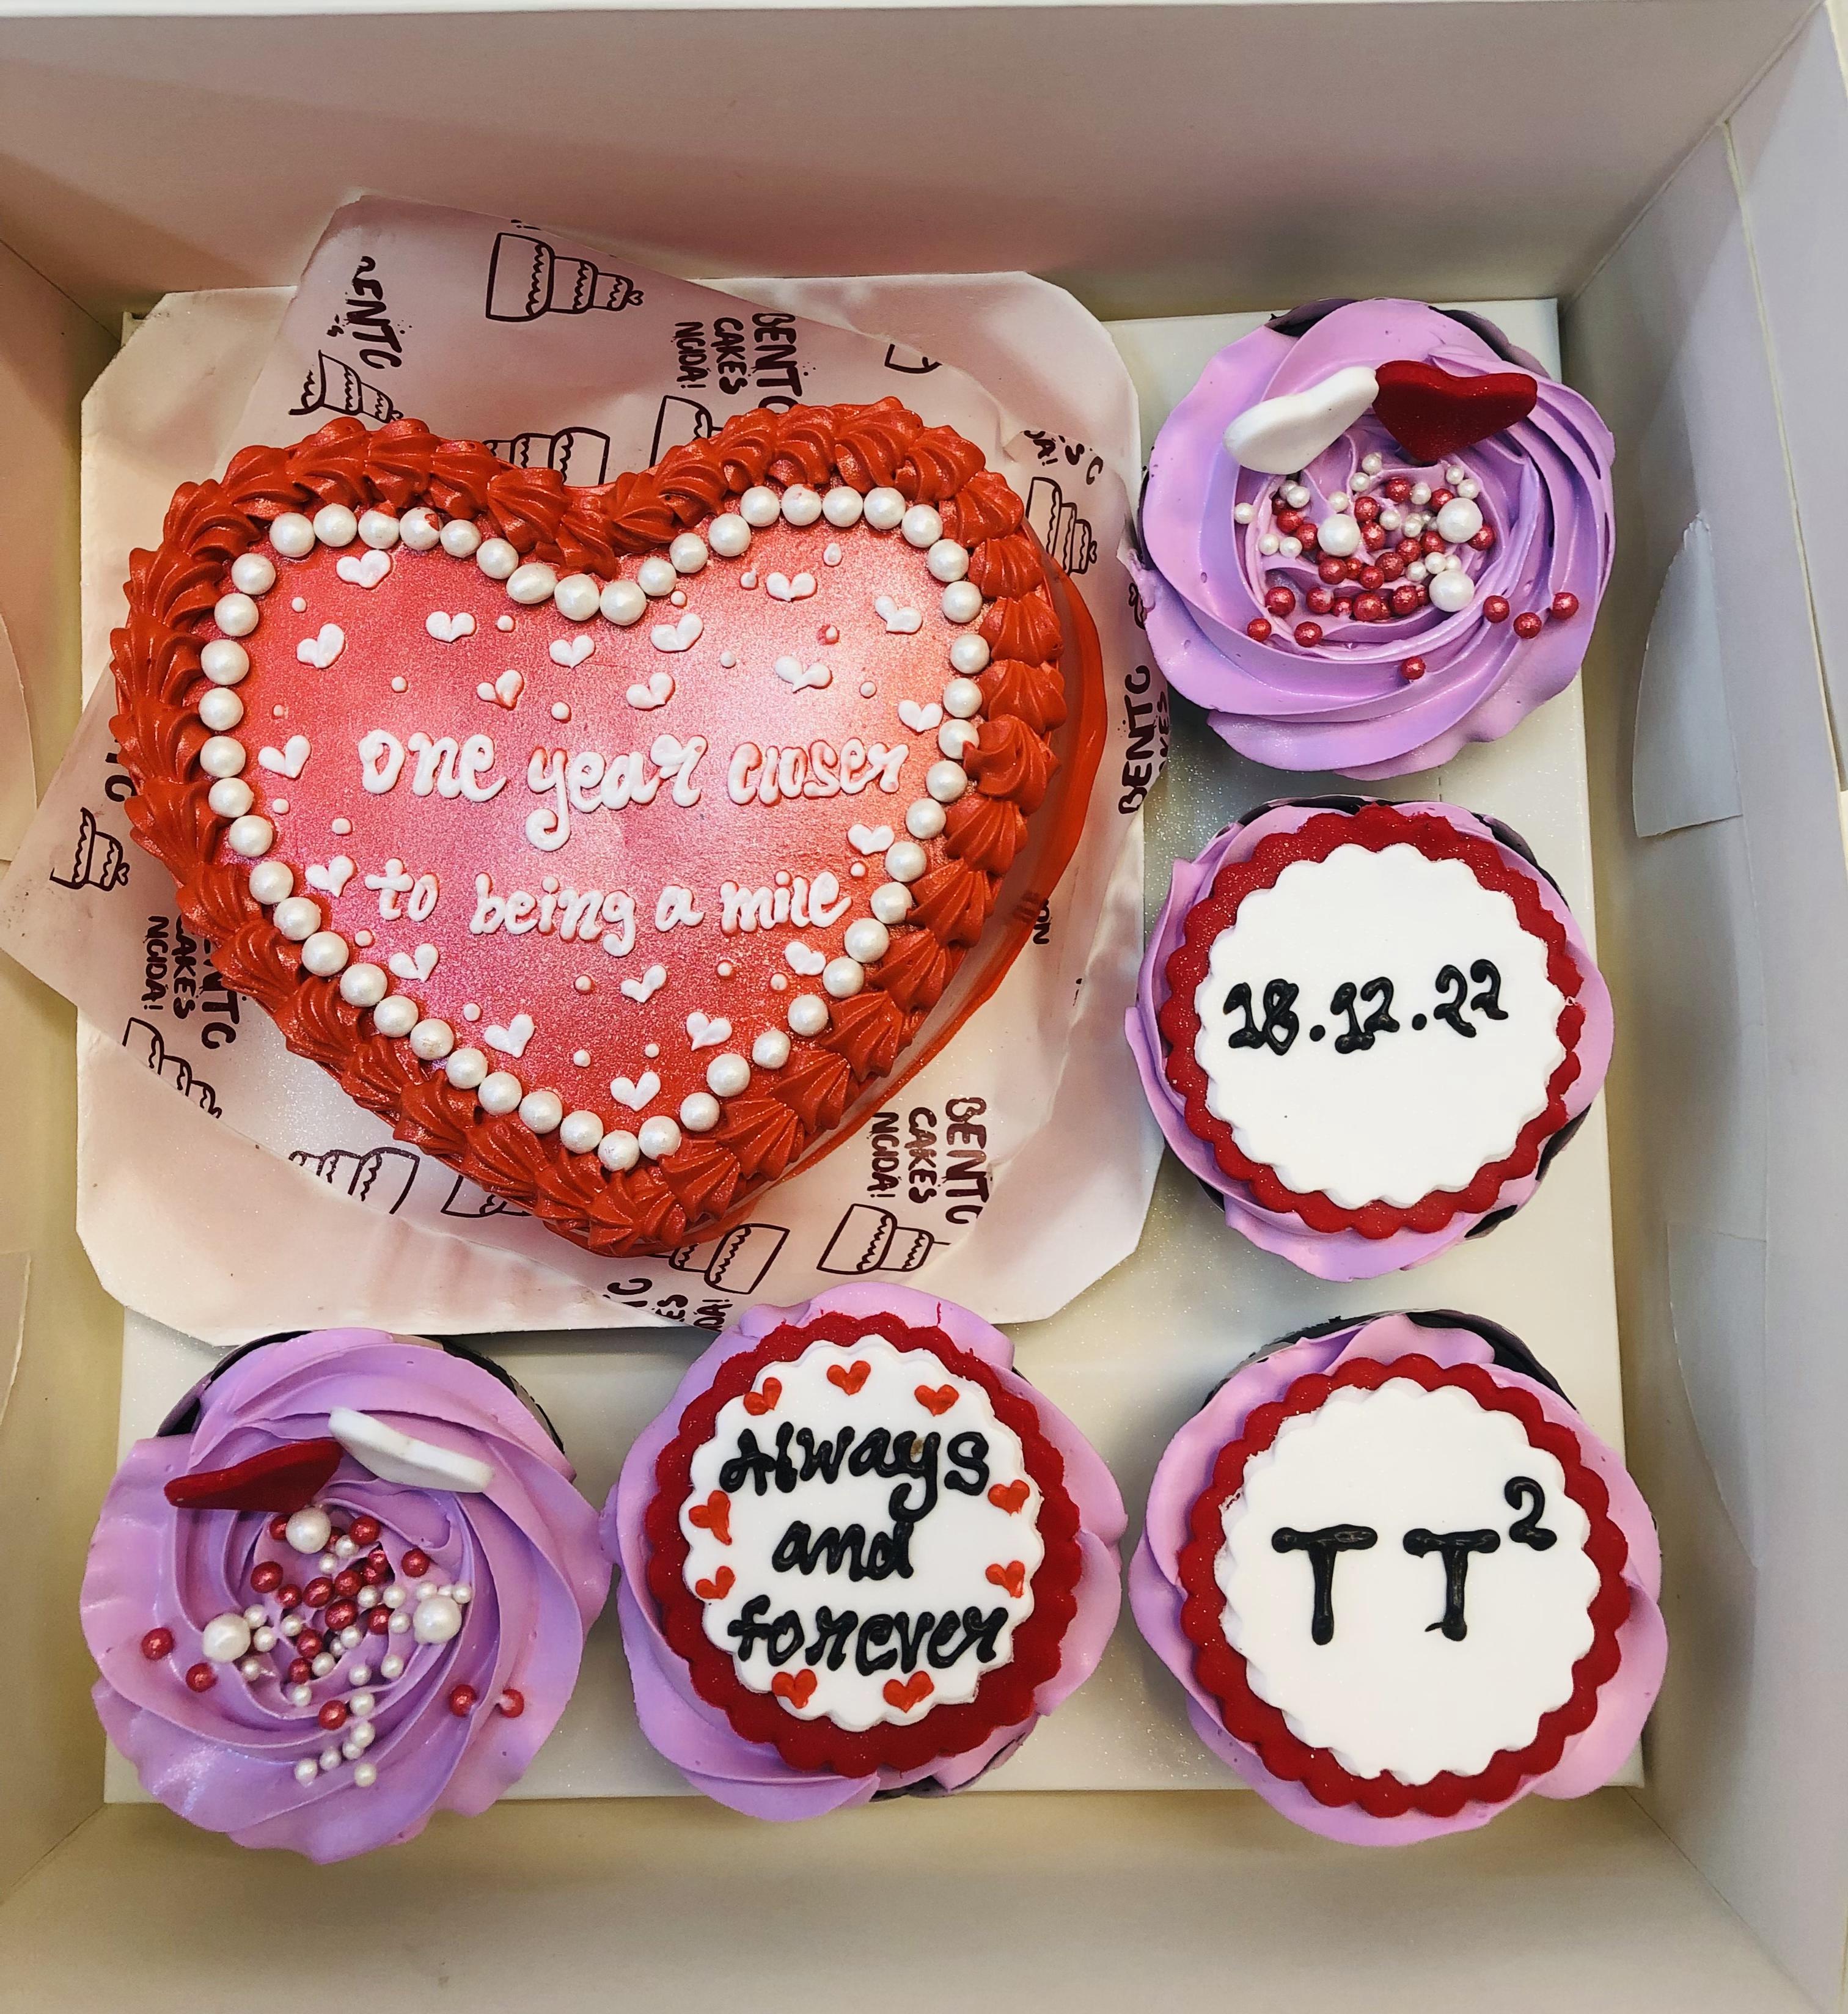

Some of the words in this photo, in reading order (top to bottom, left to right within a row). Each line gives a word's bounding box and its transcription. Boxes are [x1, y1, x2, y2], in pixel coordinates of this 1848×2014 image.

[711, 317, 748, 395] CAKES
[358, 729, 508, 803] one
[525, 733, 708, 852] year
[727, 737, 910, 806] closer
[365, 858, 440, 923] to
[468, 871, 637, 958] being
[654, 885, 706, 933] a
[1222, 958, 1509, 1056] 18.12.22
[904, 1107, 937, 1204] CAKES
[719, 1421, 989, 1523] Always
[771, 1520, 914, 1583] and
[727, 1594, 1009, 1677] forever
